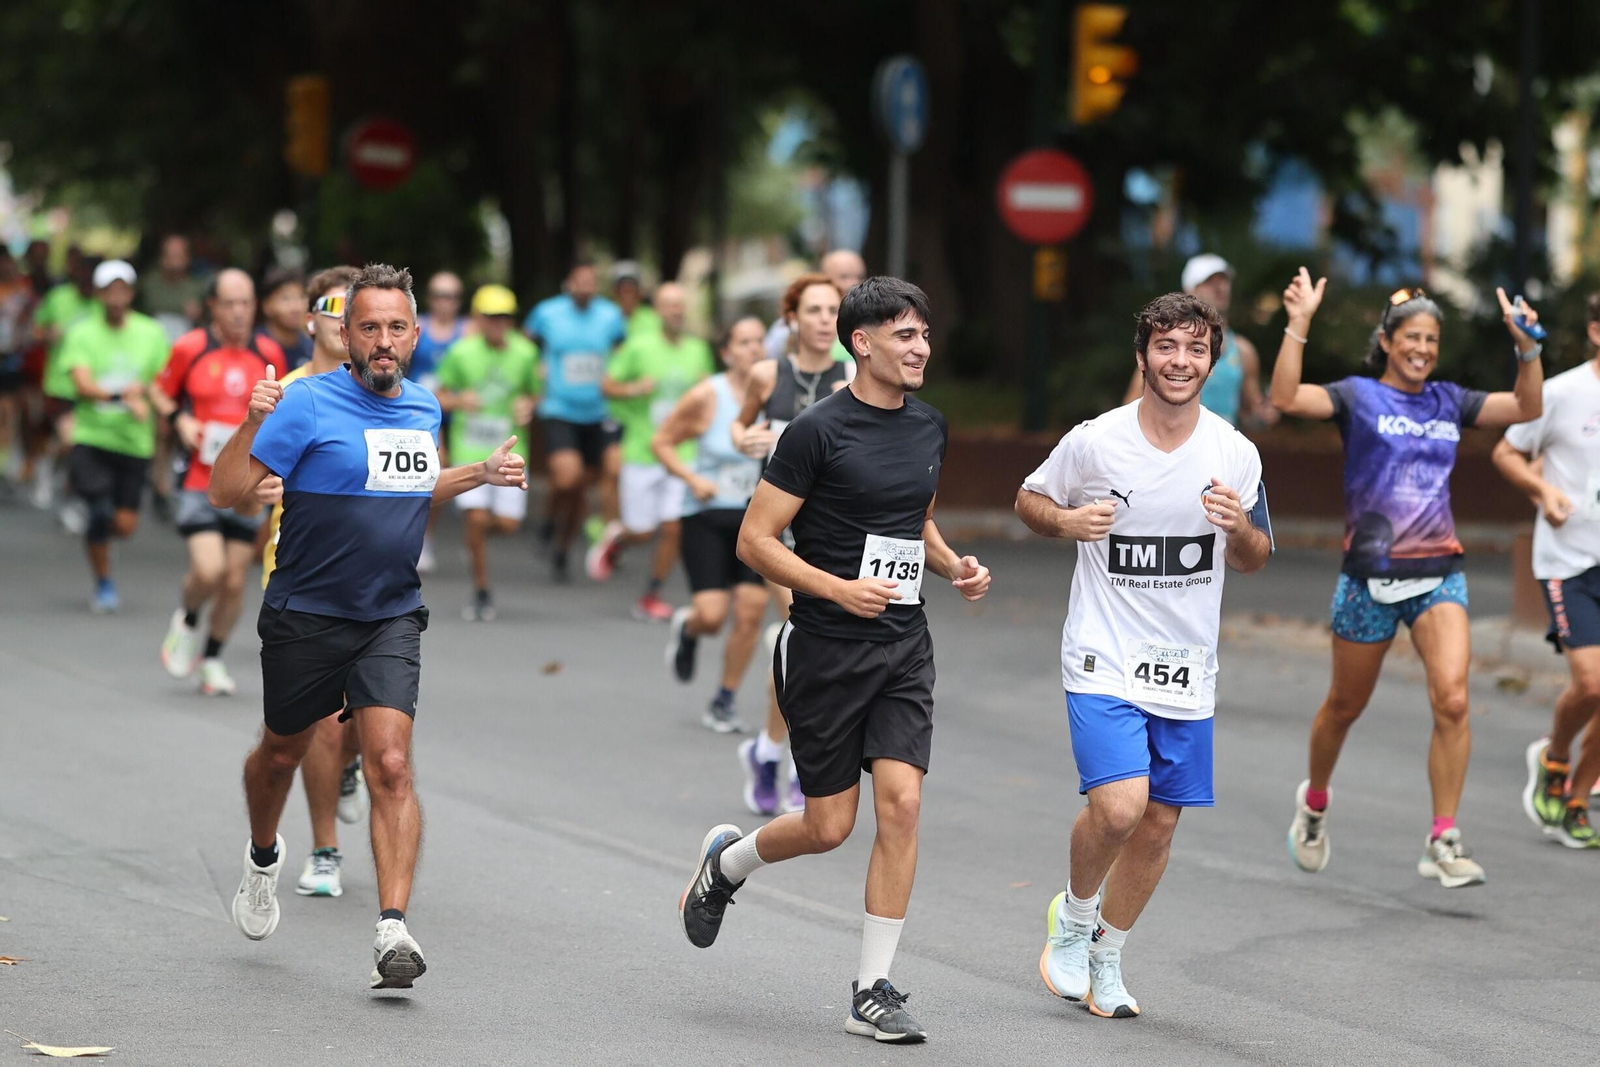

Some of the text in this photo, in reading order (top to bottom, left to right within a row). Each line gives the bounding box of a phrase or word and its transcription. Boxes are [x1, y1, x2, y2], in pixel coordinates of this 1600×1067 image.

[379, 451, 428, 473] 706
[1115, 542, 1157, 568] TM
[869, 558, 920, 581] 1139
[1110, 576, 1212, 589] TM Real Estate Group
[1134, 662, 1190, 689] 454
